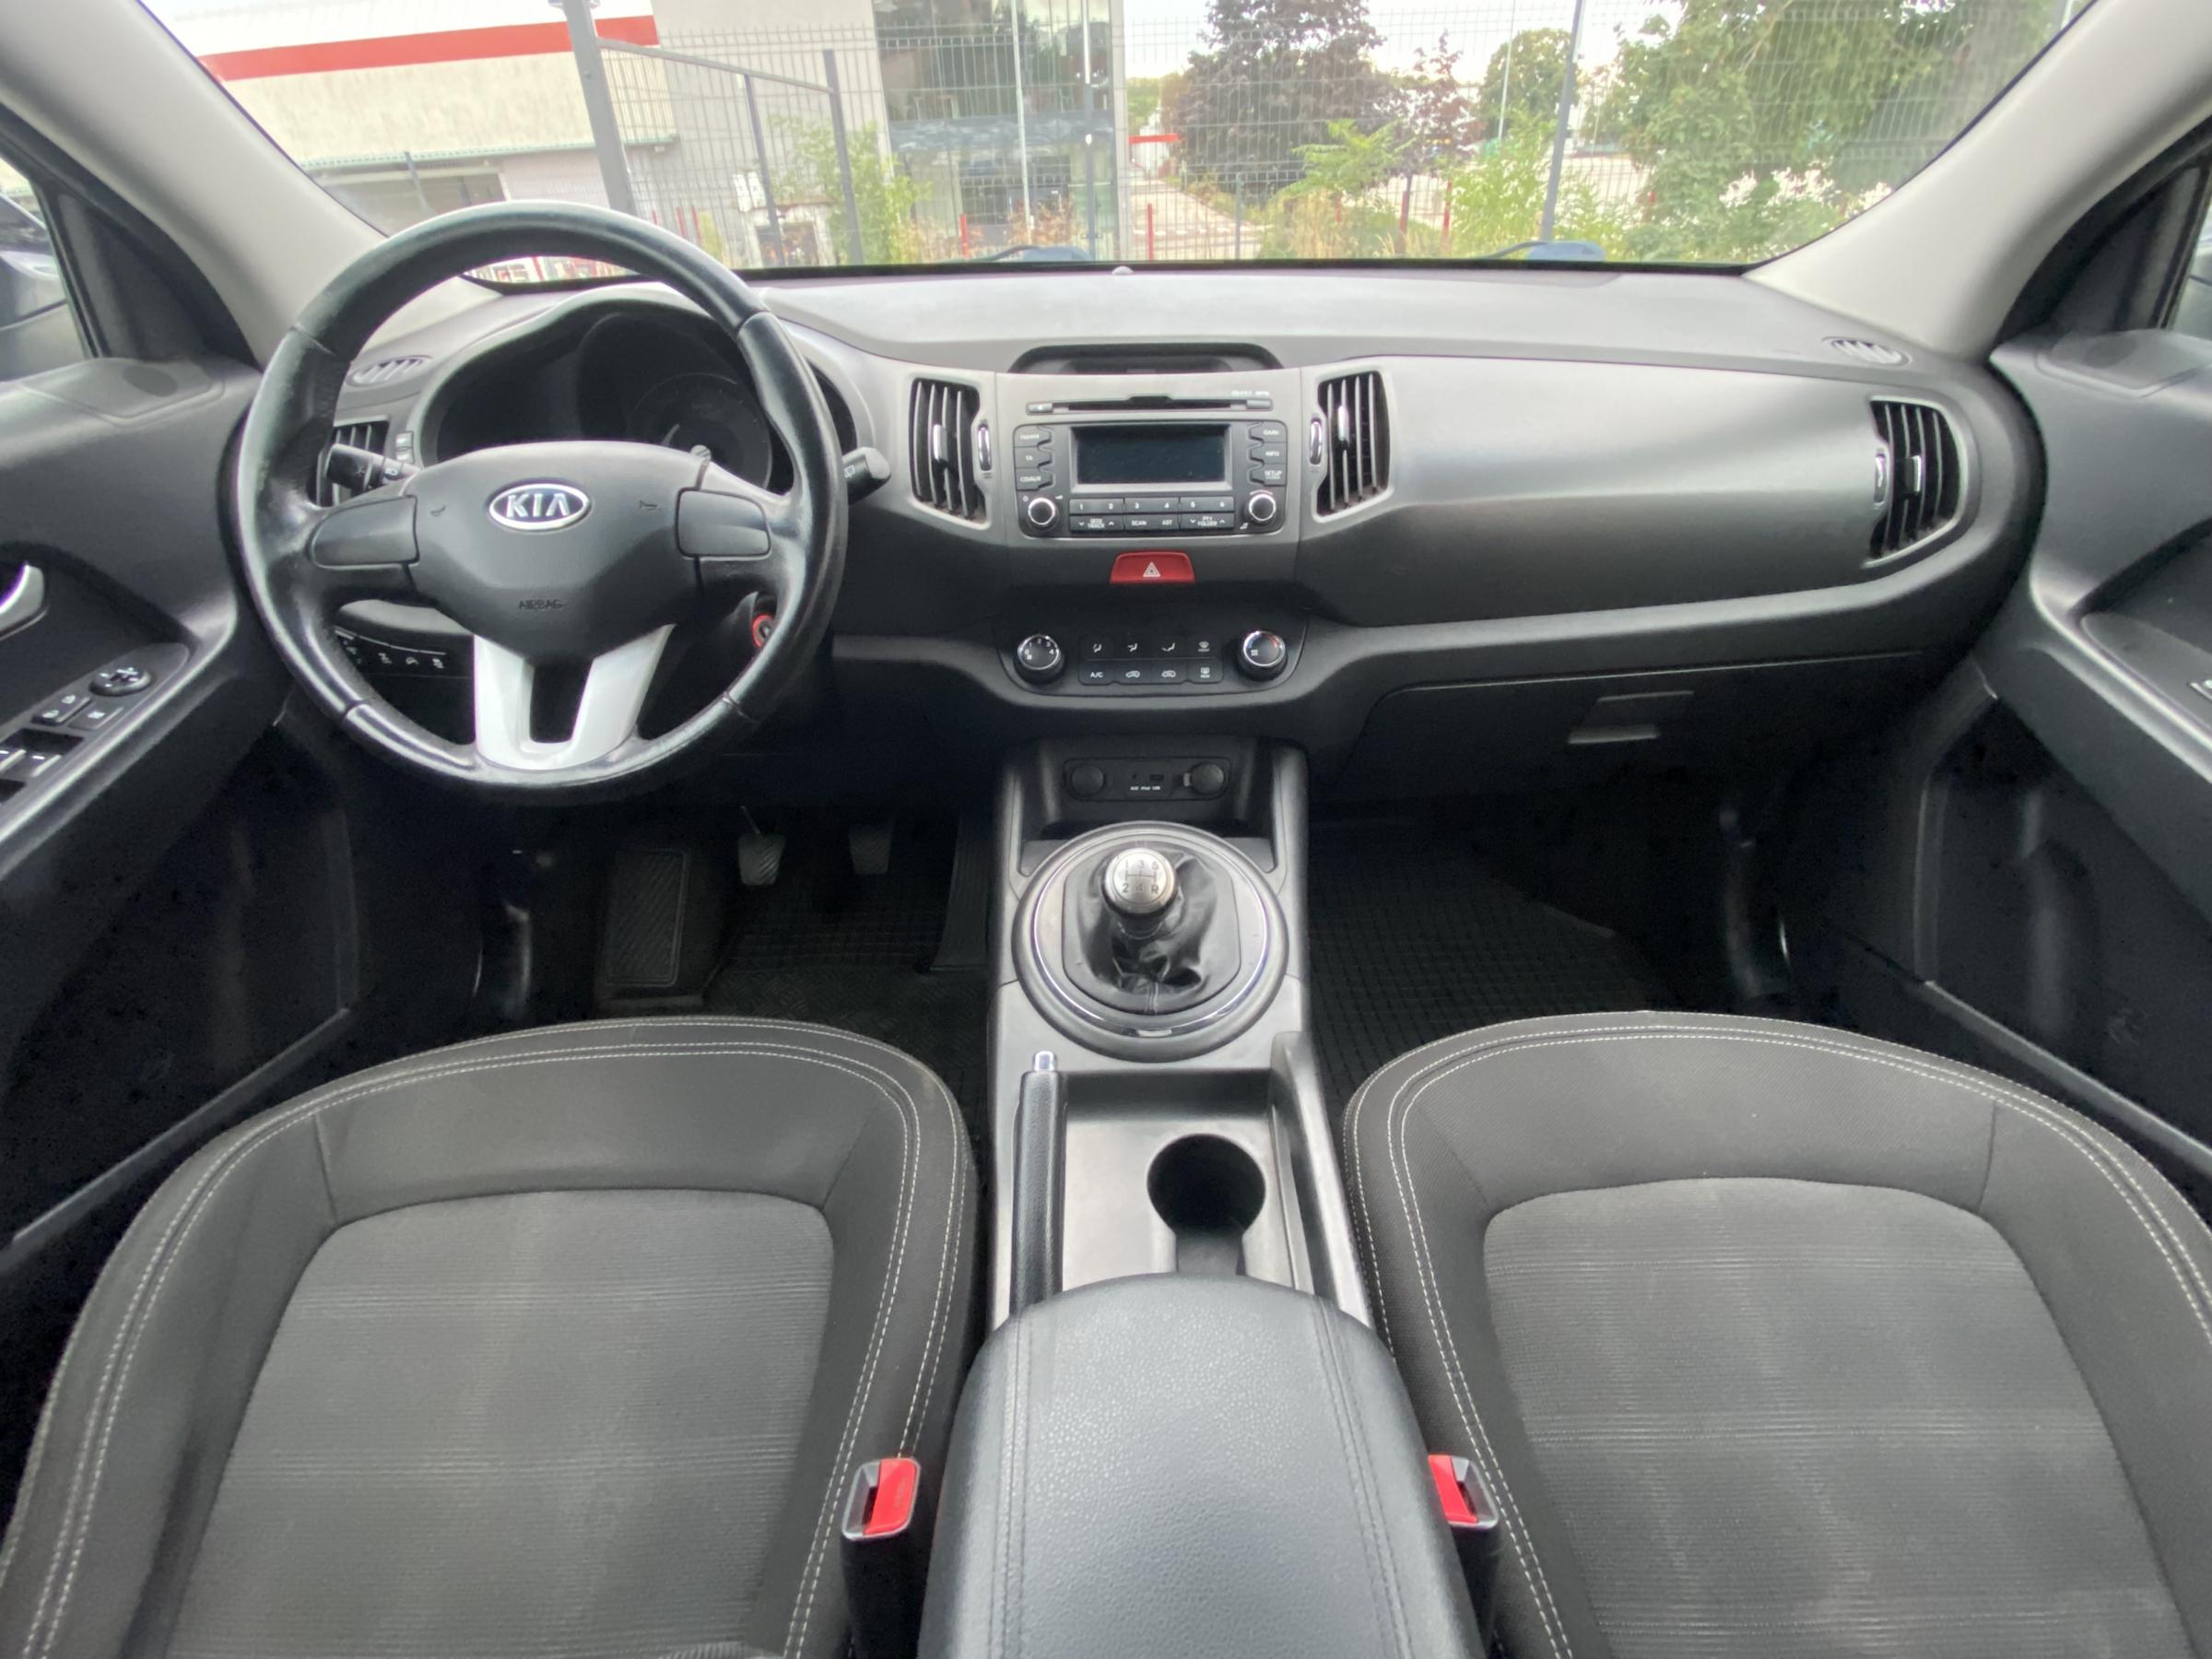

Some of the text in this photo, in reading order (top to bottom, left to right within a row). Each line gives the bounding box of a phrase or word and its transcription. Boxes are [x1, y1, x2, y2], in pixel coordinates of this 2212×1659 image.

[506, 493, 571, 517] KIA
[519, 598, 564, 609] AIRBAG
[1137, 860, 1145, 868] 3
[1123, 883, 1129, 893] 2
[1151, 885, 1159, 895] R
